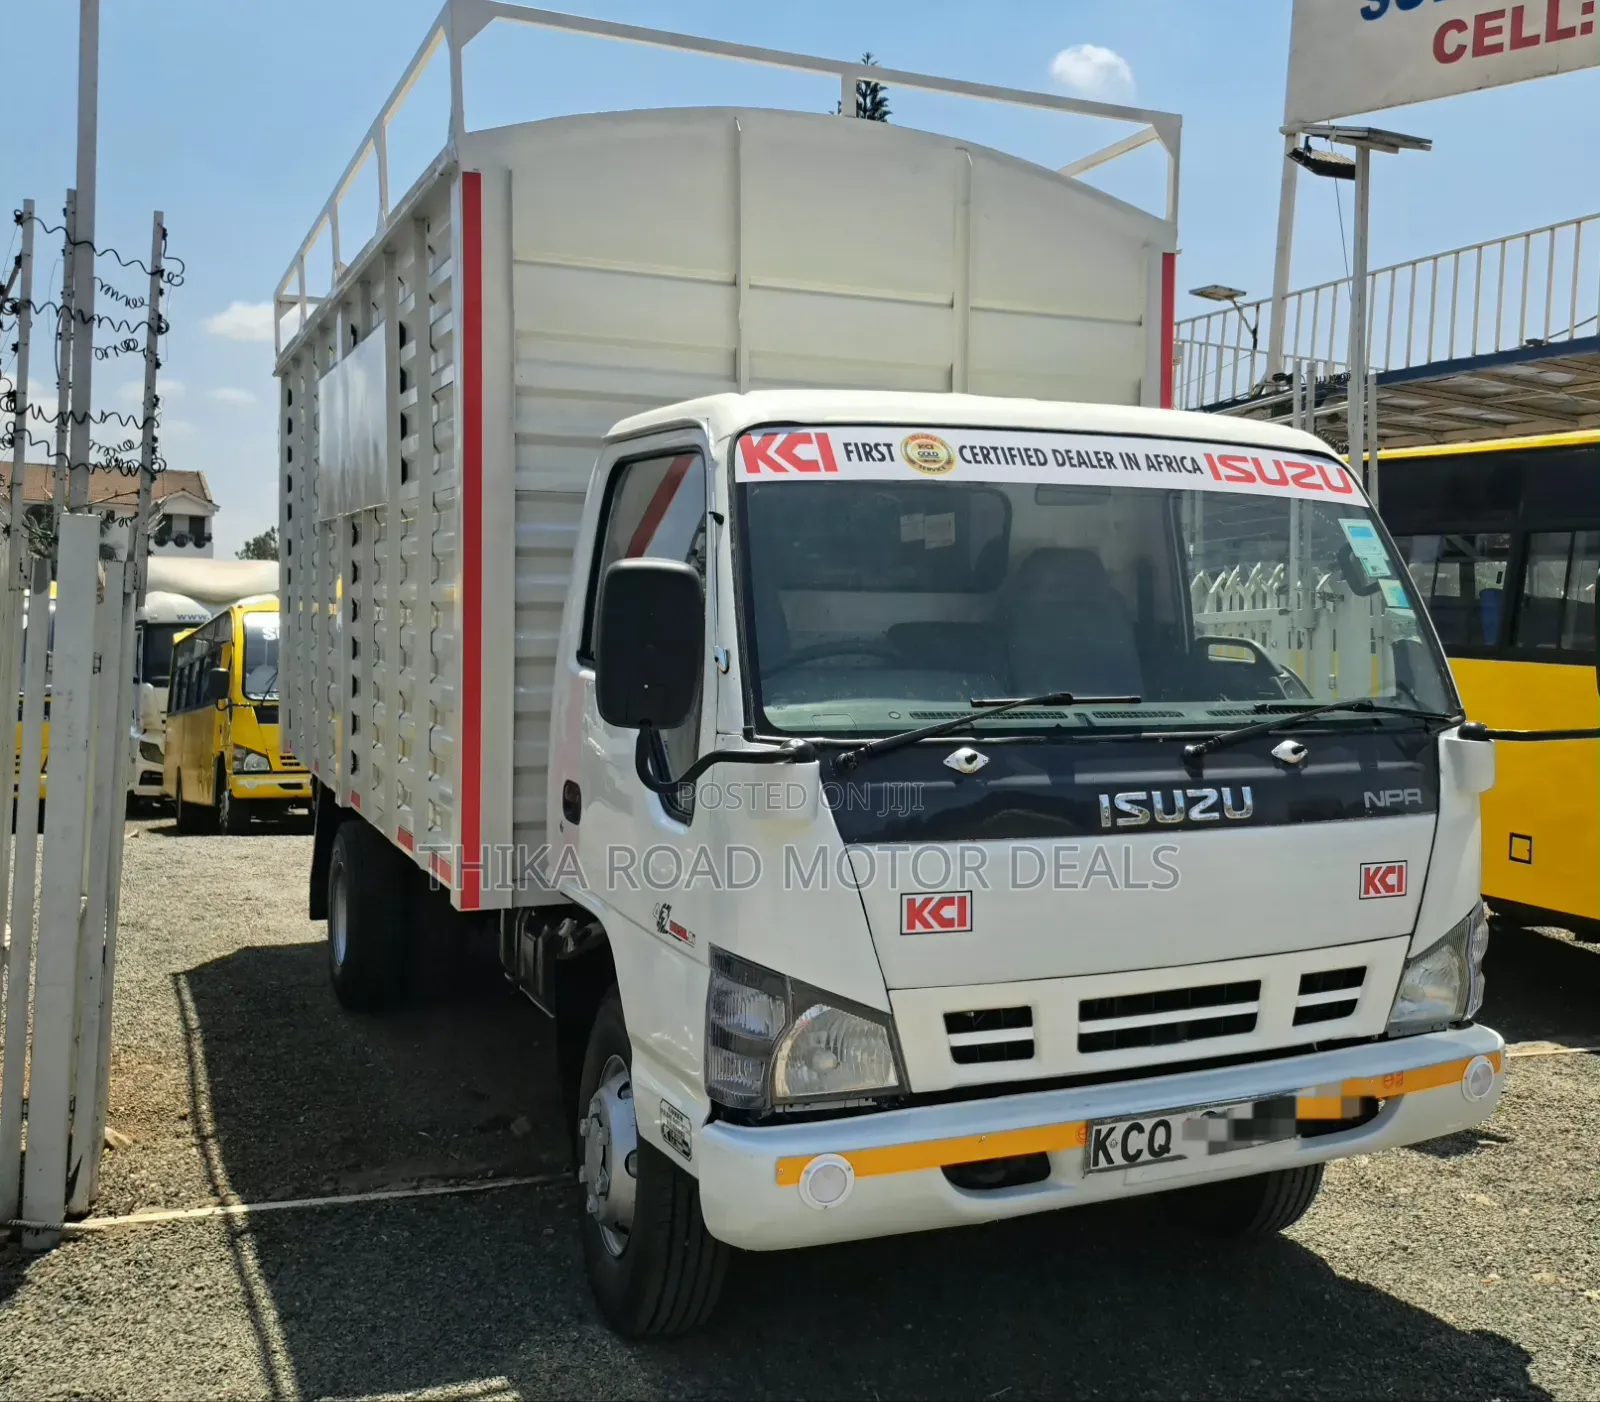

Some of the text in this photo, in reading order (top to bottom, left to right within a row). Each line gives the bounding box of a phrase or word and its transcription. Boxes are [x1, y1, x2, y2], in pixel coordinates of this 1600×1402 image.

[1433, 0, 1595, 64] CELL:
[738, 432, 895, 474] KCI FIRST
[958, 444, 1204, 475] CERTIFIED DEALER IN AFRICA
[1203, 453, 1353, 494] ISUZU
[1099, 786, 1253, 828] ISUZU
[1363, 788, 1423, 809] NPR
[1363, 865, 1404, 896] KCI
[906, 895, 967, 930] KCI
[1092, 1118, 1172, 1168] KCQ
